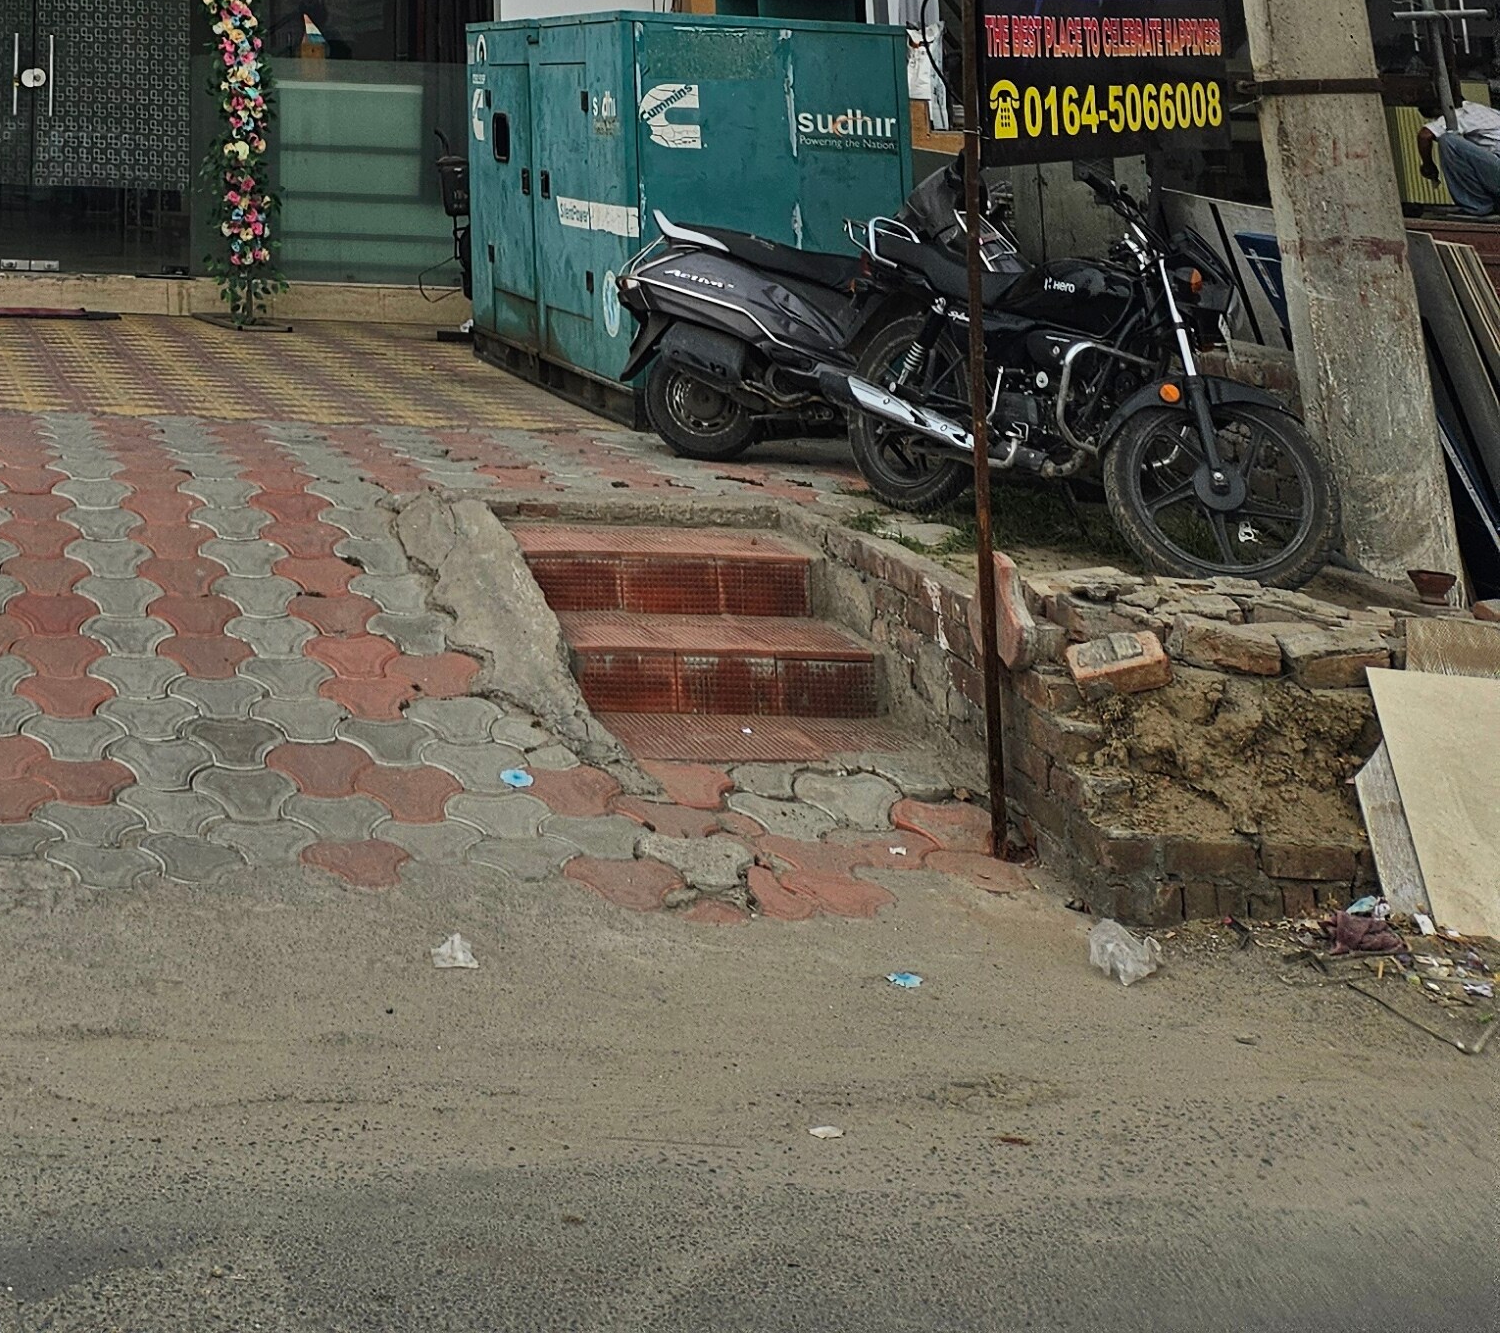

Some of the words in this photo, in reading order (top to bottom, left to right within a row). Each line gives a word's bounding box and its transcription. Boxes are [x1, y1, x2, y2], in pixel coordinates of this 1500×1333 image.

[984, 15, 1010, 58] THE
[1011, 15, 1042, 59] BEST
[1043, 17, 1083, 59] PLACE
[1083, 17, 1100, 59] TO
[1102, 17, 1163, 59] CELEBRATE
[1164, 18, 1222, 58] HAPPINESS
[640, 84, 693, 122] Cummins
[1024, 81, 1222, 138] 0164-5066008
[798, 109, 896, 138] sudhir
[800, 134, 843, 150] Powering
[845, 136, 862, 148] the
[863, 138, 895, 150] Nation
[1053, 280, 1075, 293] Hero
